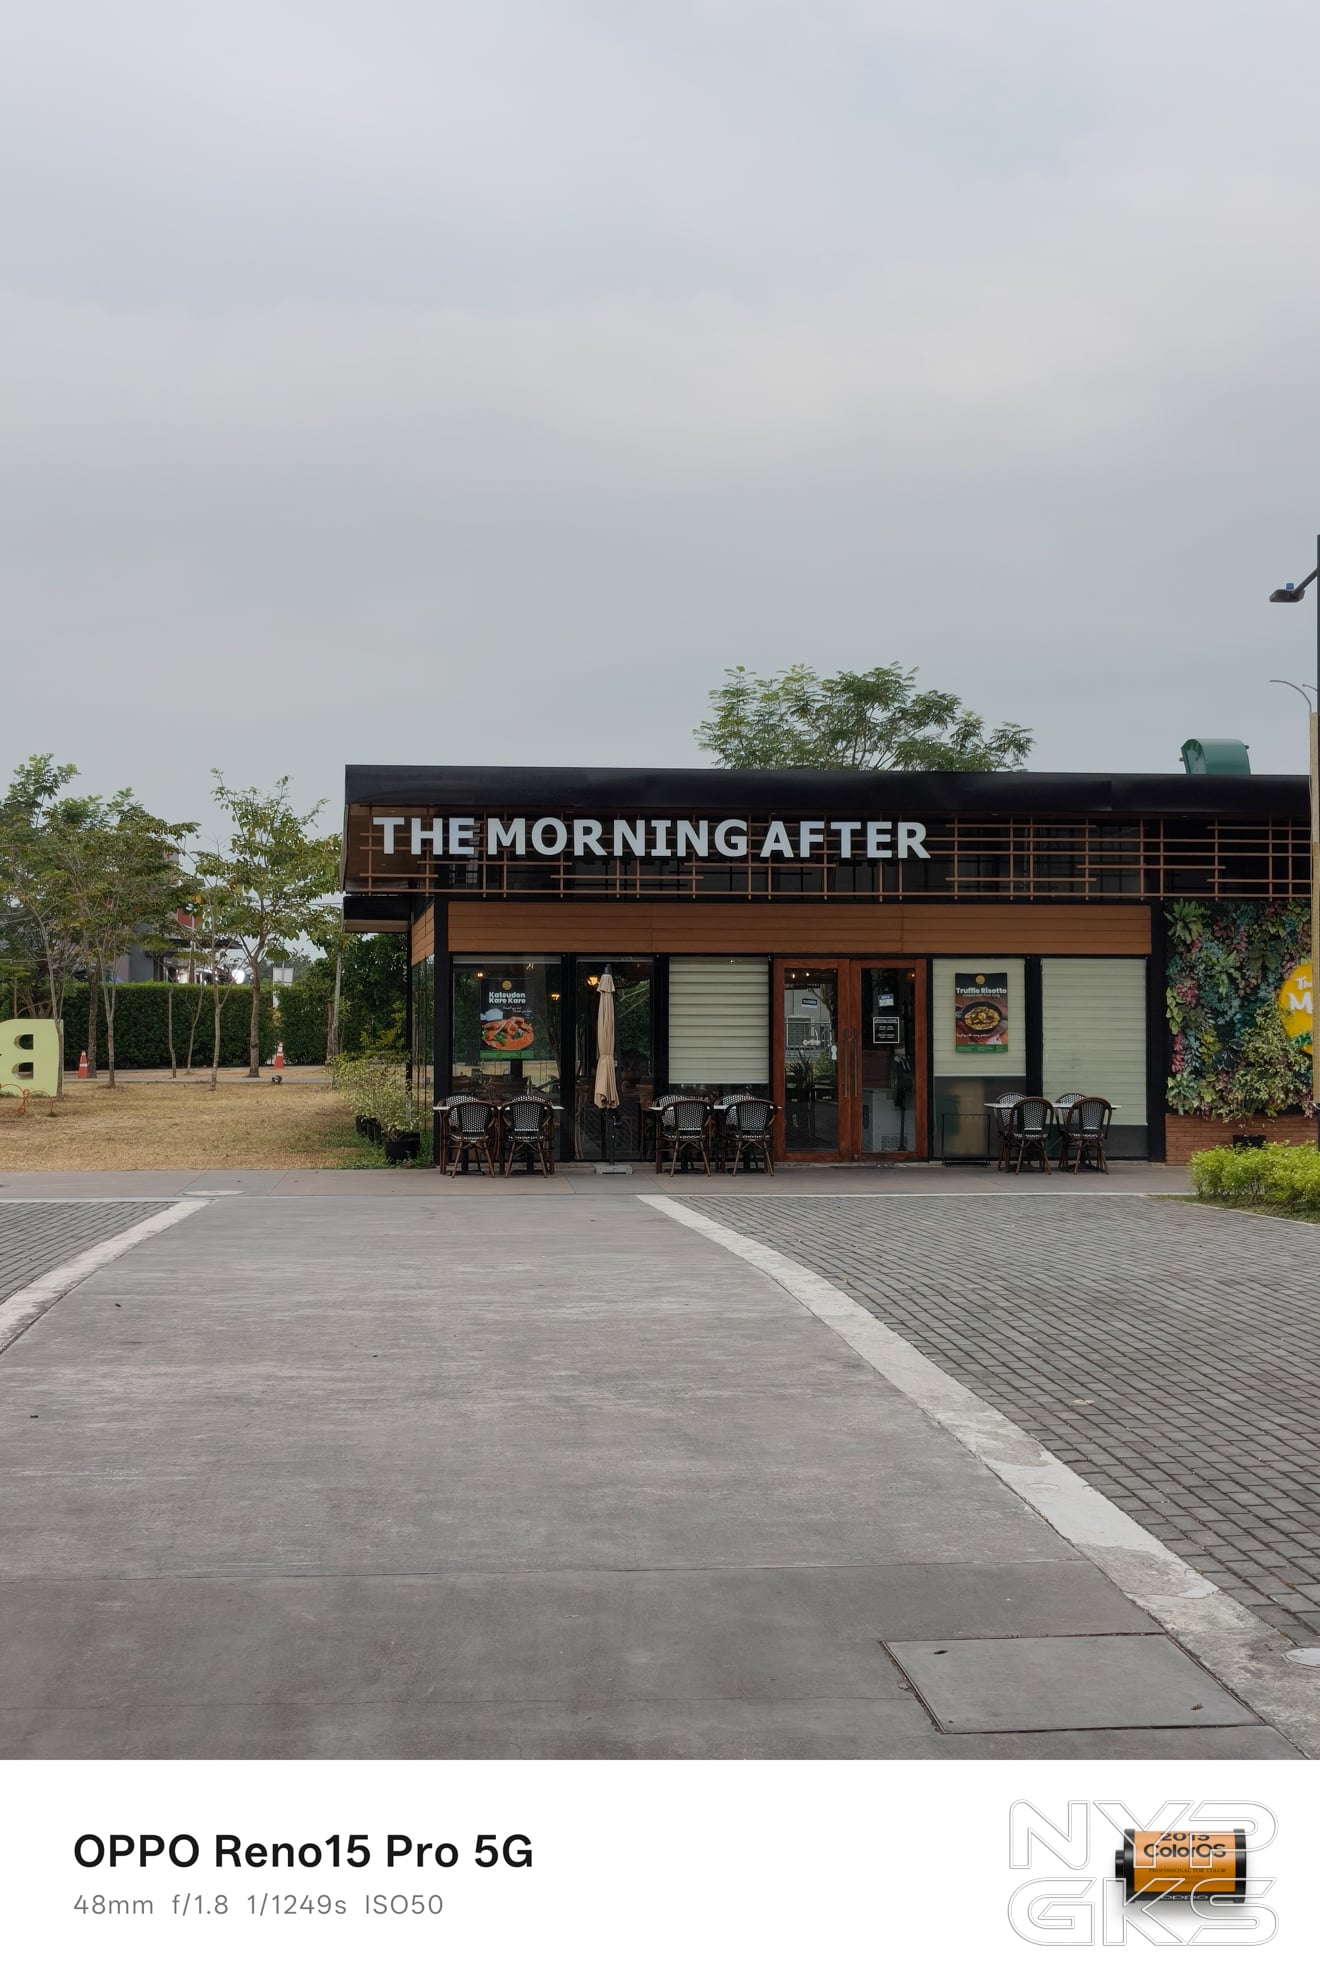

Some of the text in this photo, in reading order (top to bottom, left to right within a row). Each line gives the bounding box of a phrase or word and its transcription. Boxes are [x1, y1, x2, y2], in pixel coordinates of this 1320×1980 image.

[373, 817, 931, 859] THE MORNING AFTER
